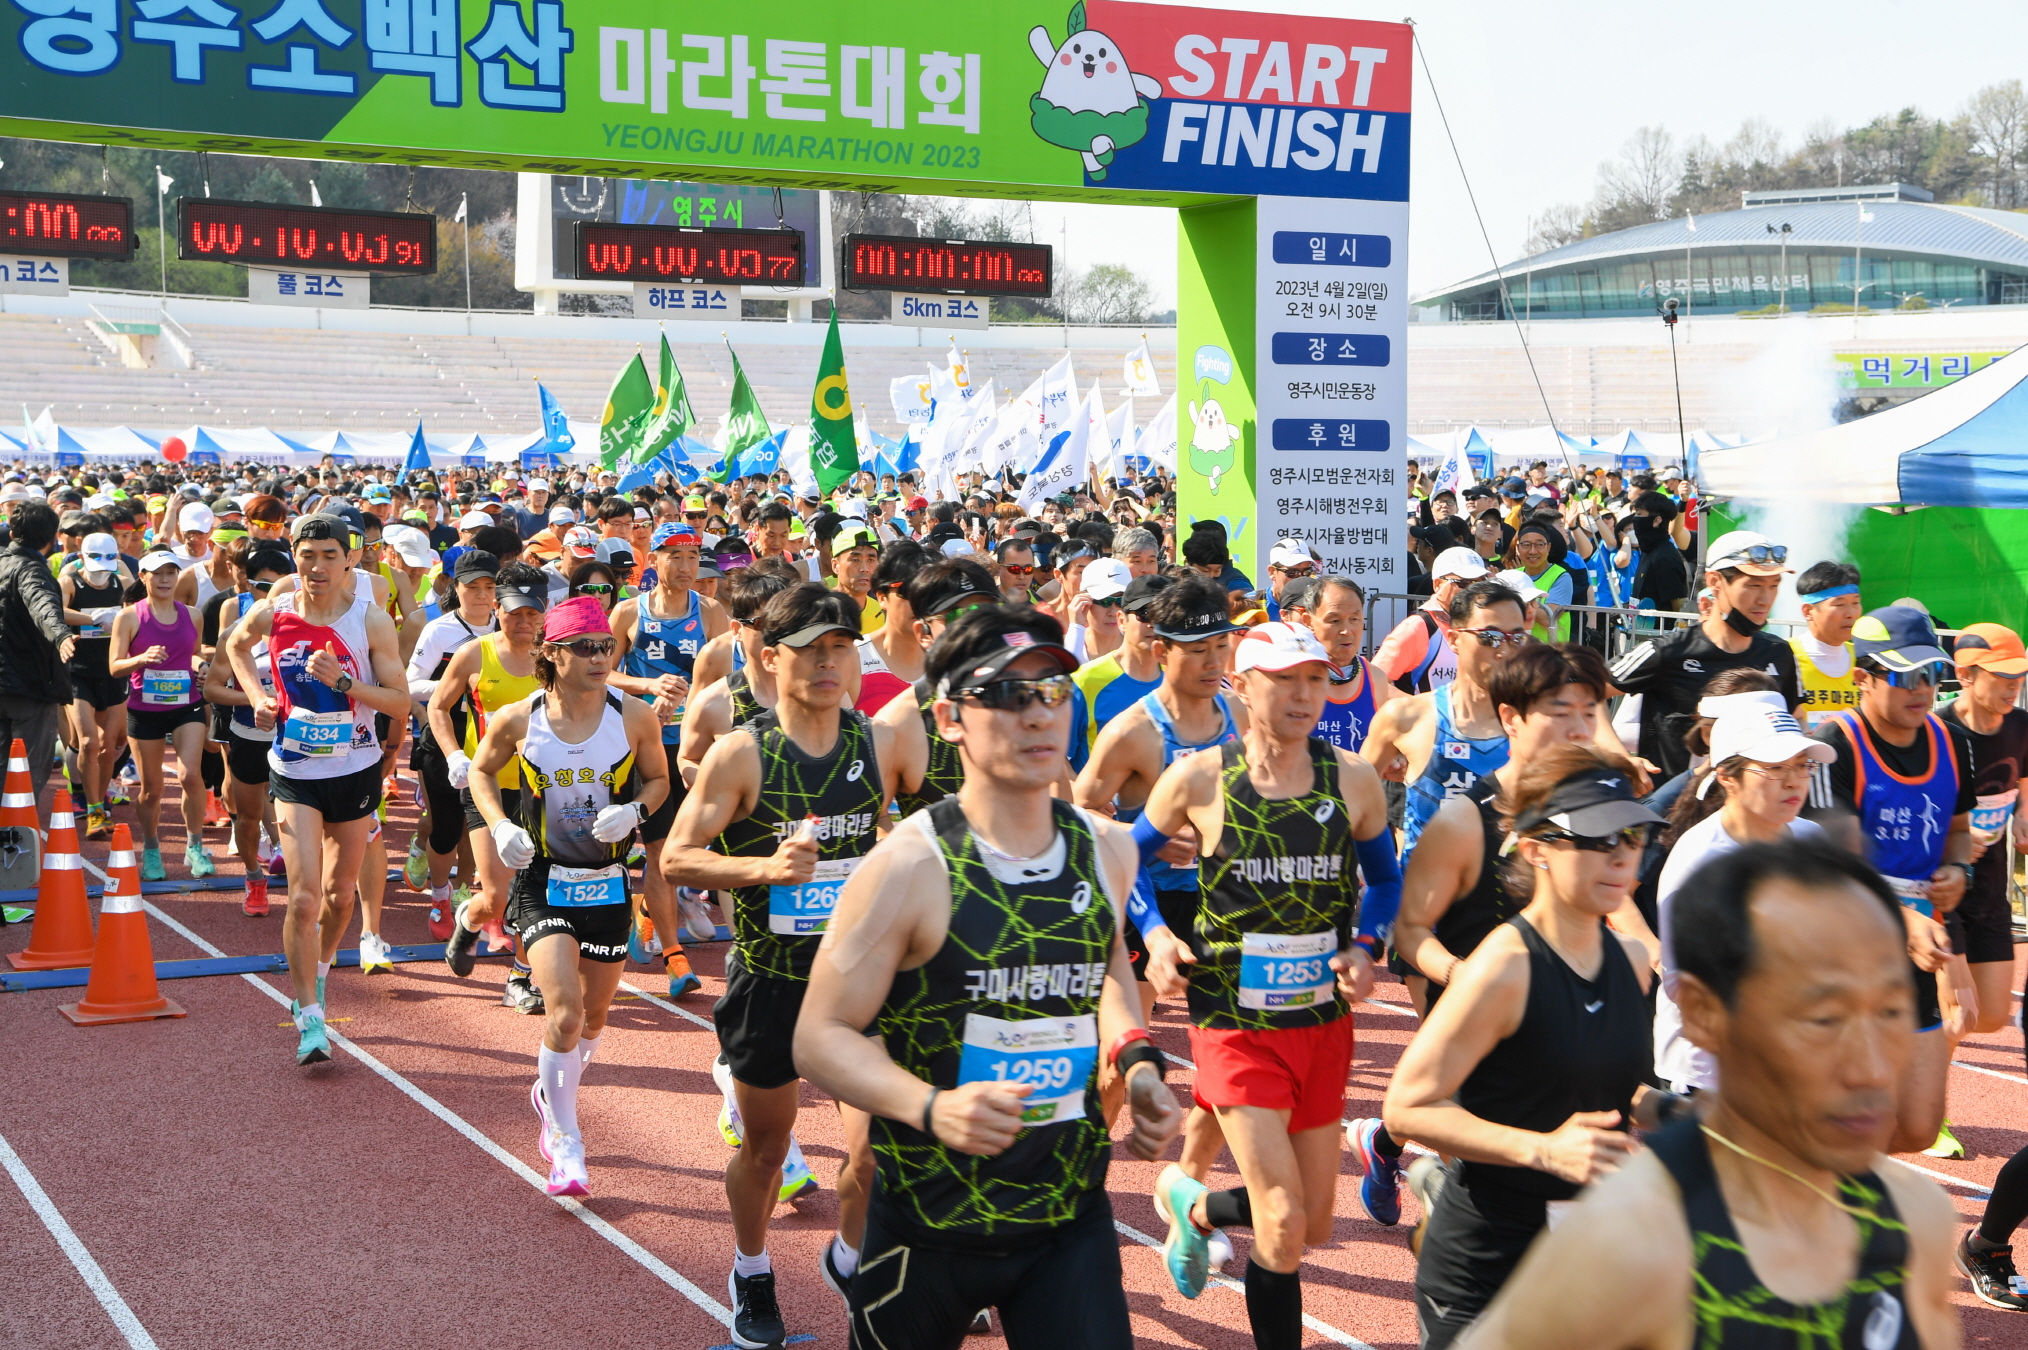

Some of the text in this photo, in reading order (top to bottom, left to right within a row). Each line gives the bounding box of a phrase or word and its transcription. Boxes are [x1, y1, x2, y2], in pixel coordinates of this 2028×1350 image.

[15, 0, 981, 135] 영주소백산 마라톤대회
[1168, 33, 1388, 107] START
[601, 123, 981, 170] YEONGJU MARATHON 2023
[1162, 101, 1387, 174] FINISH
[17, 260, 59, 284] 코스
[278, 273, 344, 298] 풀 코스
[1275, 281, 1389, 300] 2023년 4월 2일(일)
[1655, 274, 1810, 296] 영주국민체육센터
[649, 287, 727, 311] 하프 코스
[903, 298, 979, 319] 5km 코스
[1286, 303, 1378, 320] 오전 9시 30분
[1196, 355, 1231, 375] Fighting
[1287, 382, 1376, 400] 영주시민운동장
[1269, 468, 1394, 484] 영주시모범운전자회
[1277, 498, 1387, 515] 영주시해병전우회
[1277, 528, 1388, 545] 영주시자율방범대
[645, 639, 697, 660] 삼척
[153, 681, 182, 692] 1654
[300, 726, 339, 741] 1334
[1318, 721, 1341, 732] 마산
[1880, 807, 1912, 825] 마산
[772, 813, 873, 844] 구미랑마라톤
[1231, 855, 1342, 884] 구미사랑마라톤
[563, 883, 609, 902] 1522
[580, 942, 611, 954] FNR
[964, 962, 1107, 1003] 구미사랑마라톤
[1263, 960, 1322, 985] 1253
[991, 1056, 1073, 1091] 1259
